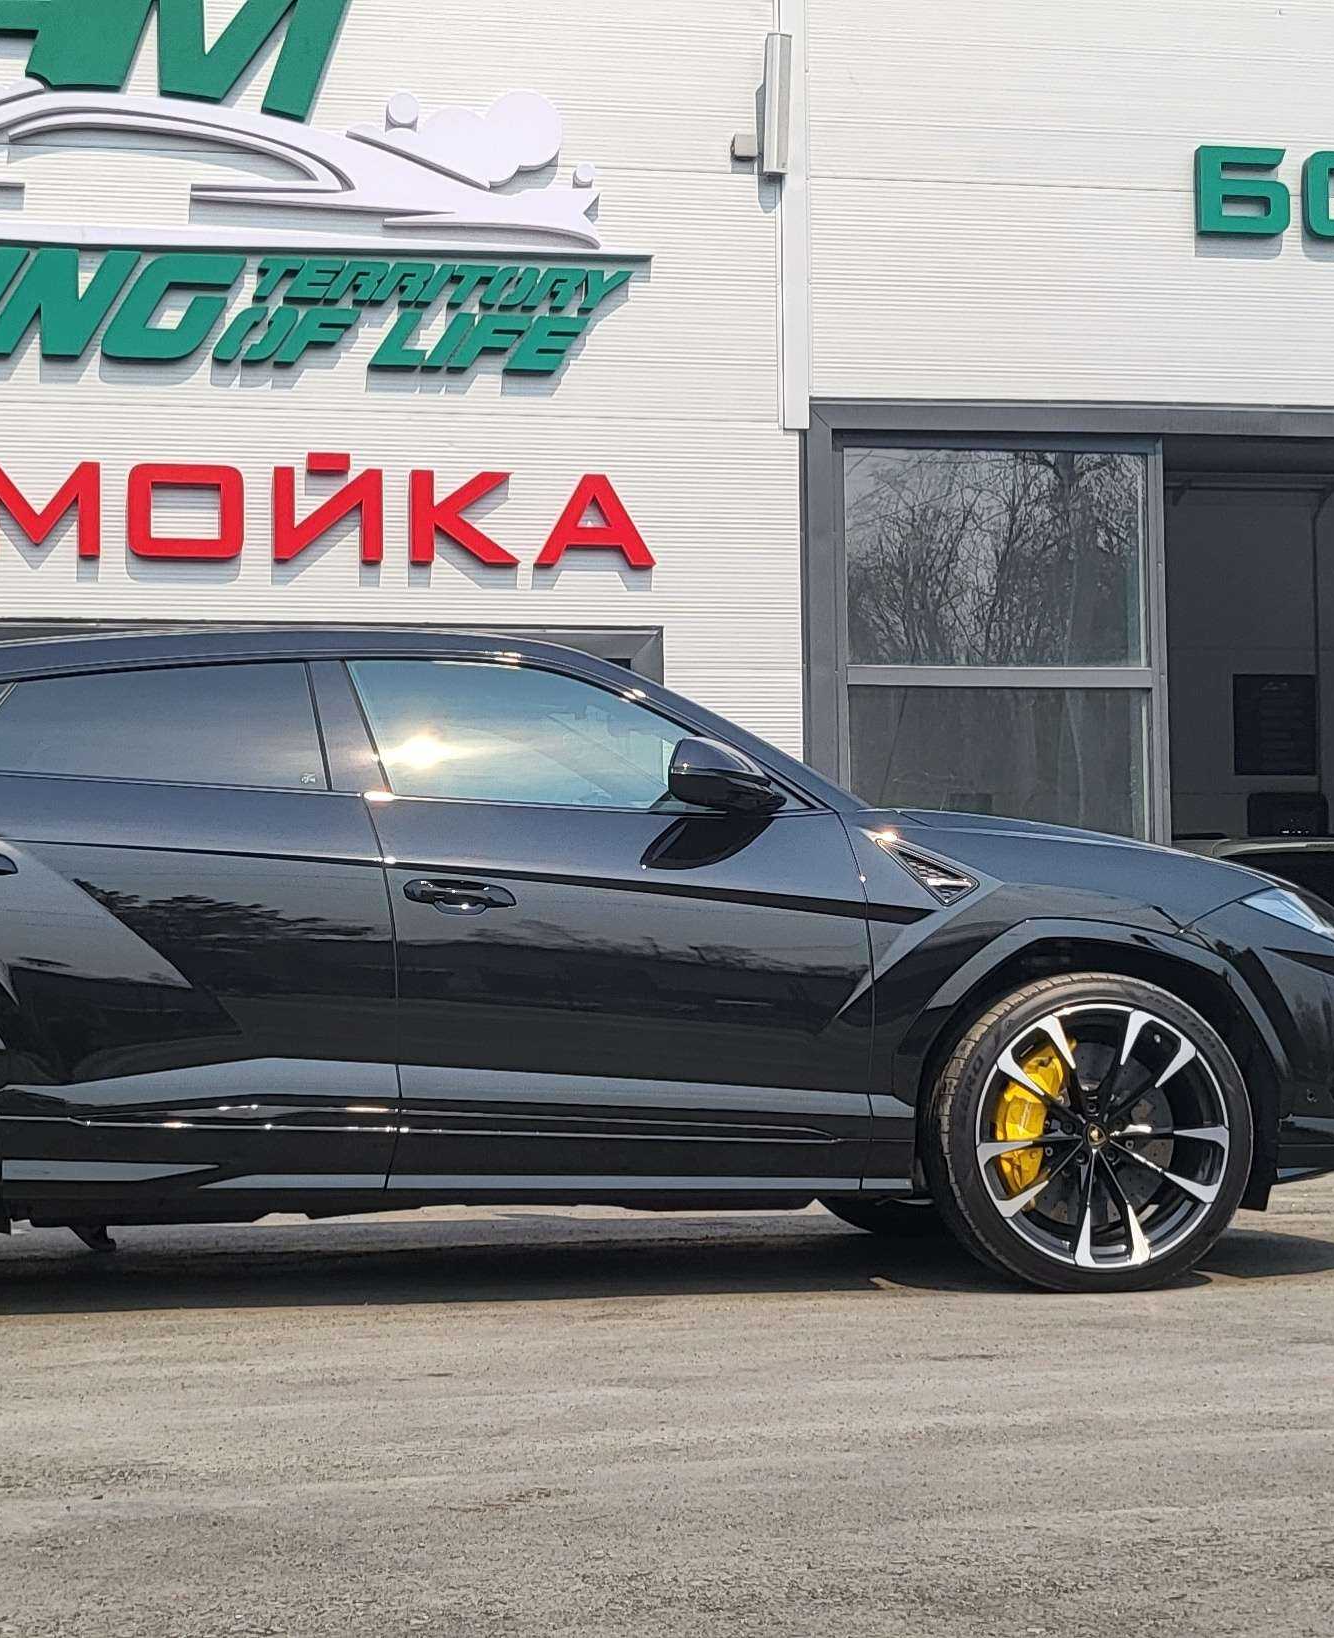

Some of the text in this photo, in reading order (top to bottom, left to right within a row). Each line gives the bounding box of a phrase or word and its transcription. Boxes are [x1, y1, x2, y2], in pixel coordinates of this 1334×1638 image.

[253, 254, 633, 312] TERRITORY
[212, 305, 592, 377] OF LIFE
